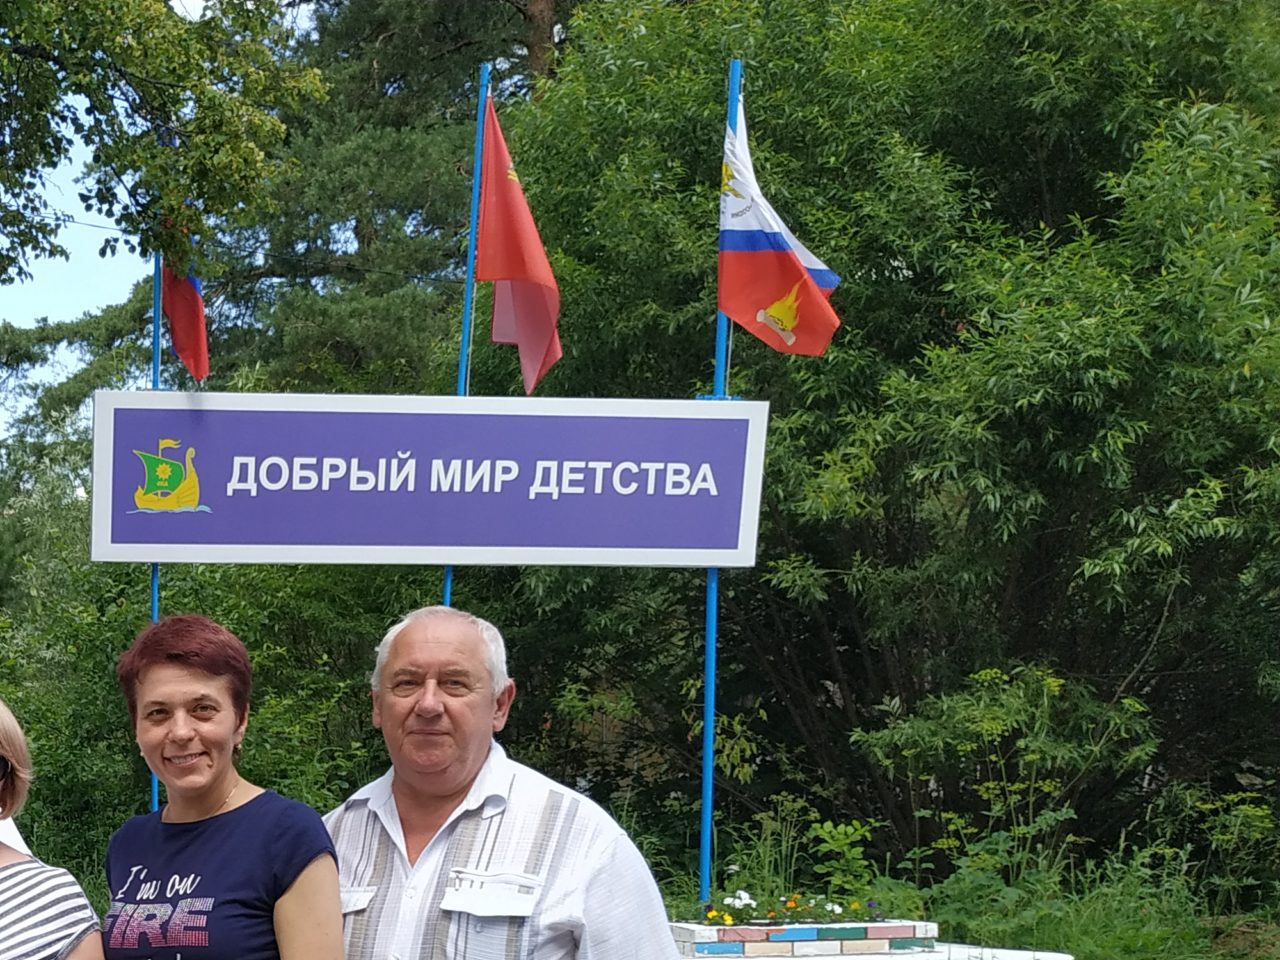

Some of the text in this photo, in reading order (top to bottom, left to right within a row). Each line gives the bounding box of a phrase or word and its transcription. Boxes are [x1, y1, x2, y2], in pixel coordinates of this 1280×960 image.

[226, 450, 719, 500] ДОБРЫЙ МИР ДЕТСТВА
[115, 864, 202, 900] I'm on
